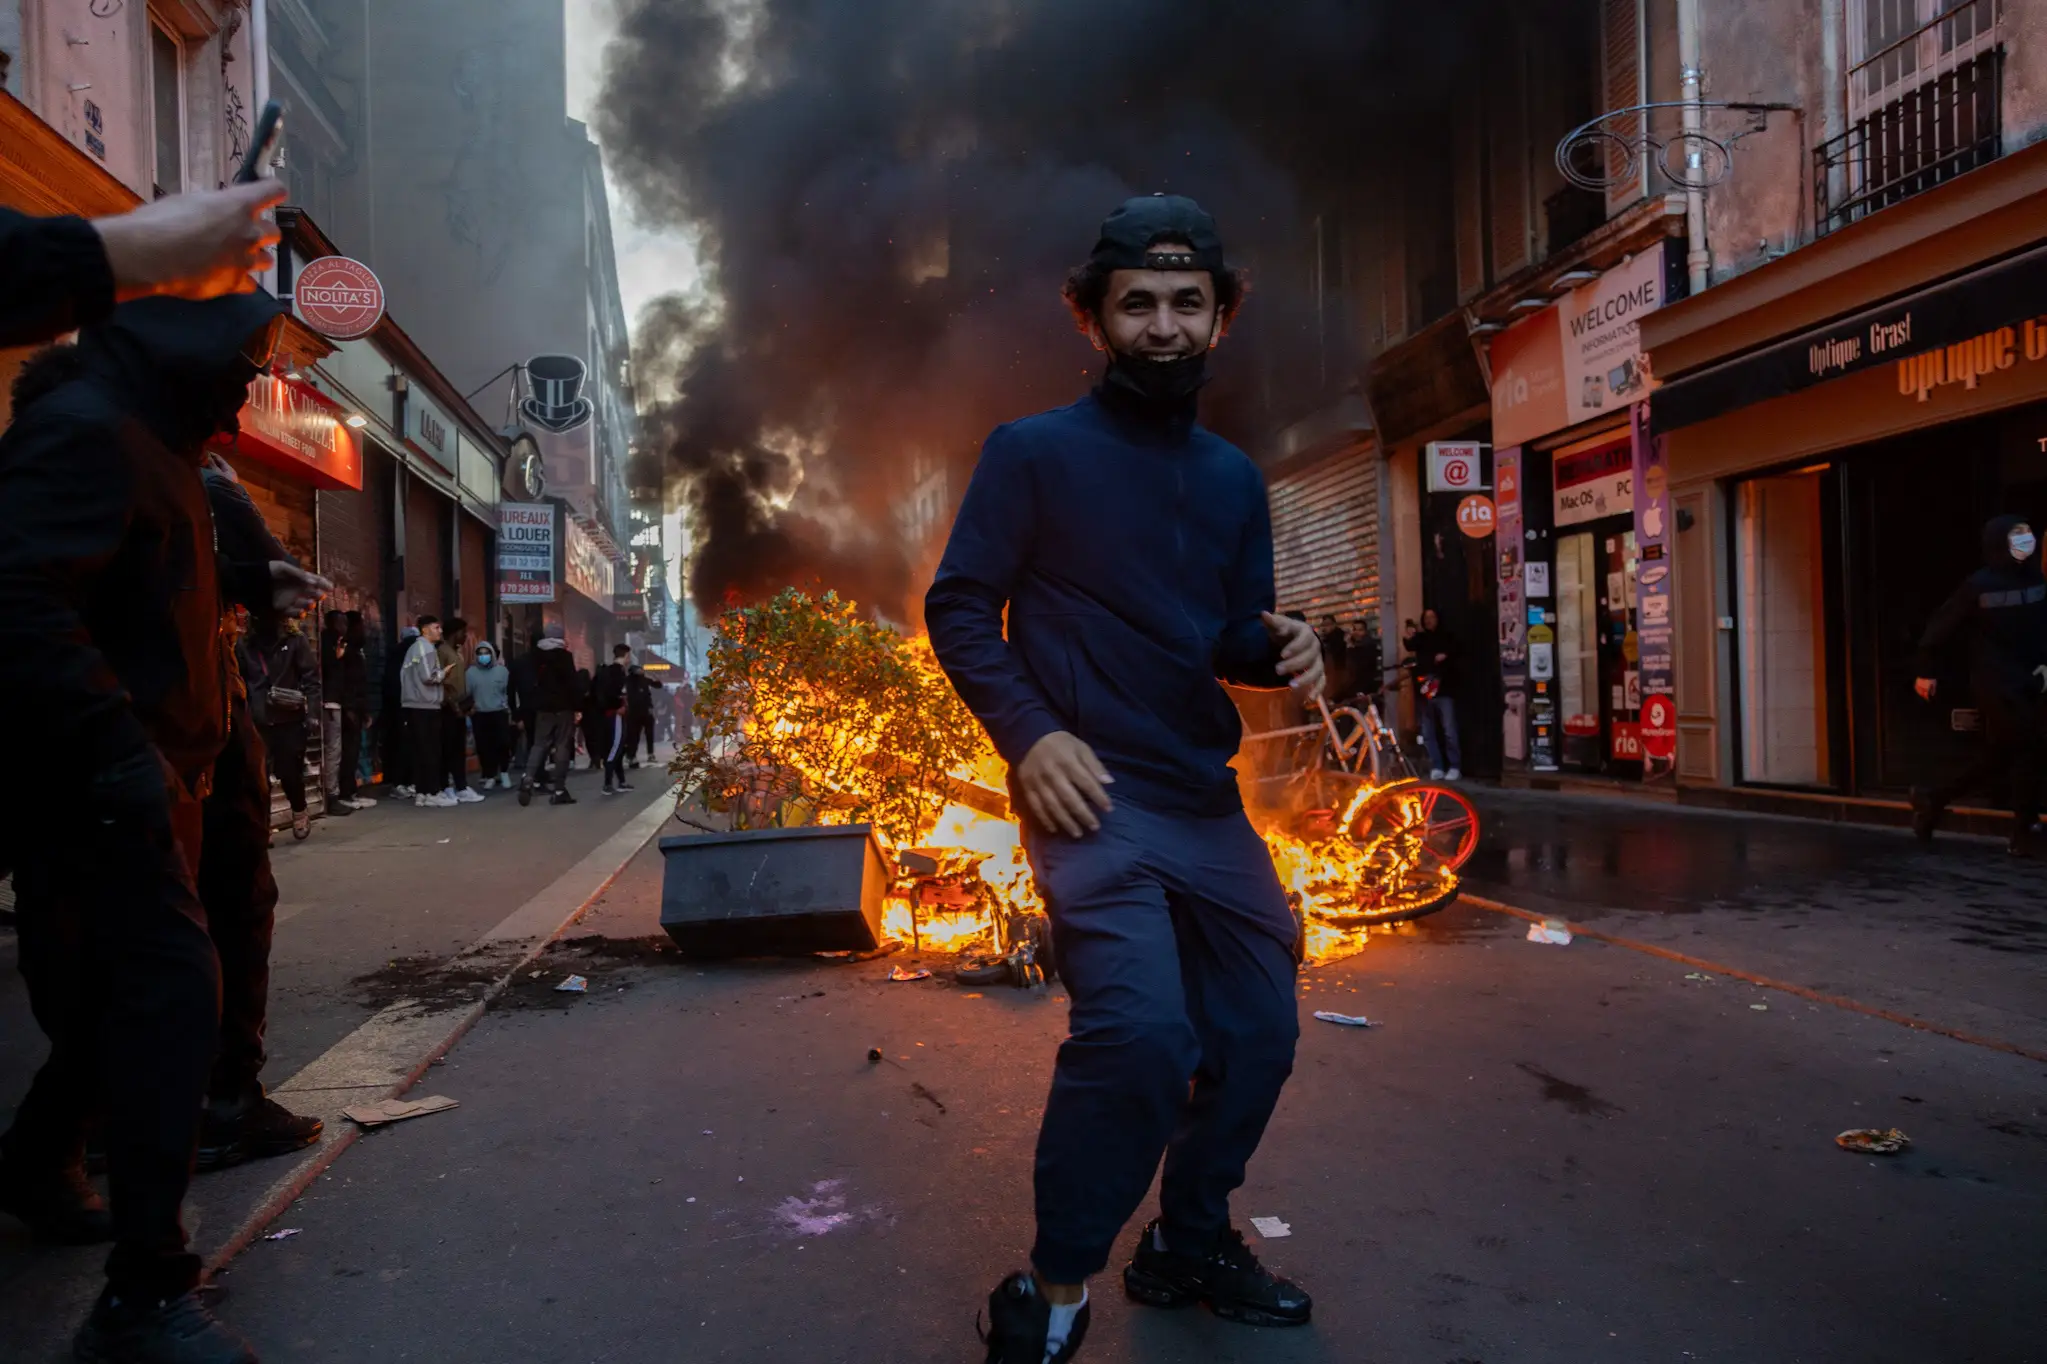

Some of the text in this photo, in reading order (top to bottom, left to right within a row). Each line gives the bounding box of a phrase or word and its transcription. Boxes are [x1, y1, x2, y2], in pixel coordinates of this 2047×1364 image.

[302, 260, 376, 288] PIZZA AL TAGLIO
[307, 290, 371, 304] NOLITA'S
[1570, 279, 1655, 338] WELCOME
[1809, 335, 1861, 377] Optique
[302, 393, 336, 453] PIZZA
[281, 432, 300, 450] STREET
[302, 443, 315, 458] FOOD
[1438, 448, 1474, 456] WELCOME
[1561, 496, 1579, 510] Mac
[1580, 489, 1593, 505] OS
[1616, 479, 1631, 496] PC
[498, 511, 550, 524] BUREAUX
[1461, 500, 1491, 521] ria
[509, 527, 550, 541] LOUER
[1615, 728, 1638, 754] ria
